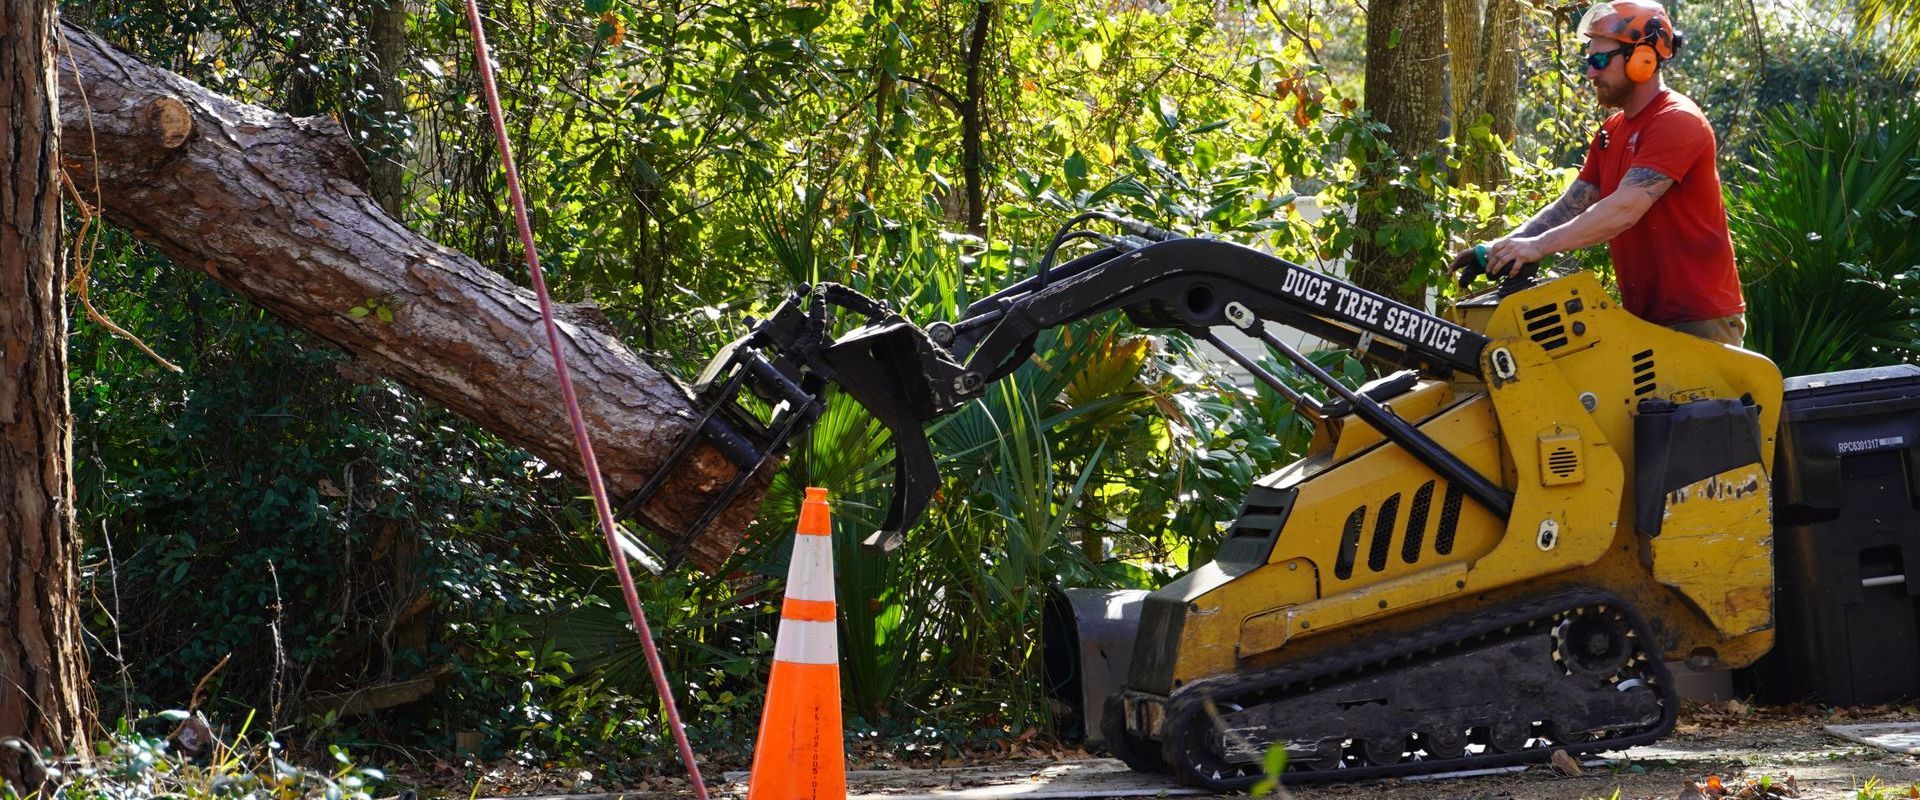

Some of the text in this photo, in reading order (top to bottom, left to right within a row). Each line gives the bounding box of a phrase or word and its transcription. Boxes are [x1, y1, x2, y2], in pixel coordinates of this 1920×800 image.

[1282, 268, 1461, 354] DUCE TREE SERVICE
[1838, 439, 1879, 453] RPC6301317
